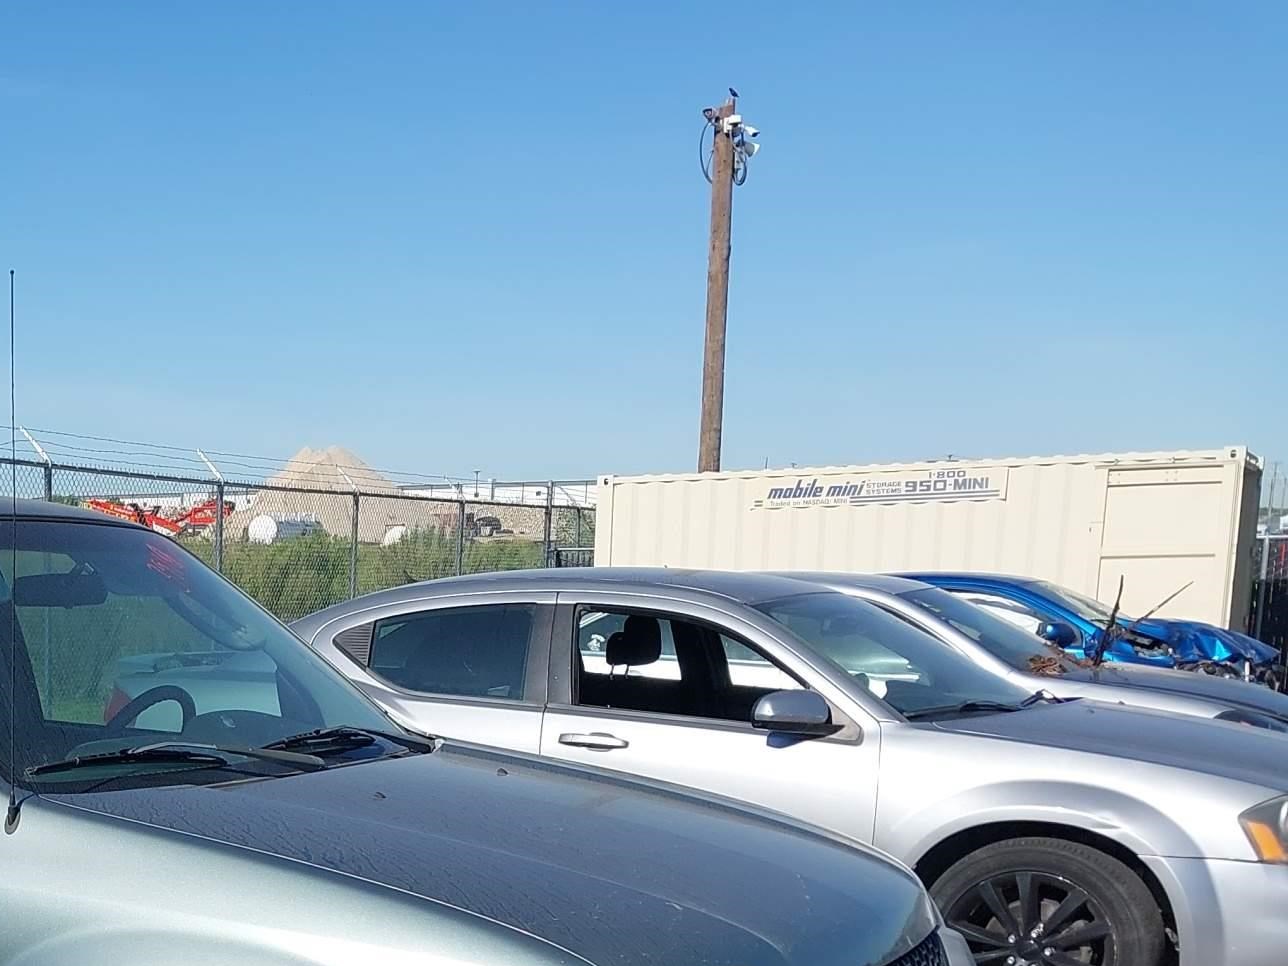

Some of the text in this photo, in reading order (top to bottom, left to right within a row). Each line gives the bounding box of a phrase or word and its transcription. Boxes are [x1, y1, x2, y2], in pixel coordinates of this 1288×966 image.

[768, 479, 866, 499] mobile mini
[905, 477, 990, 492] 950-MINI
